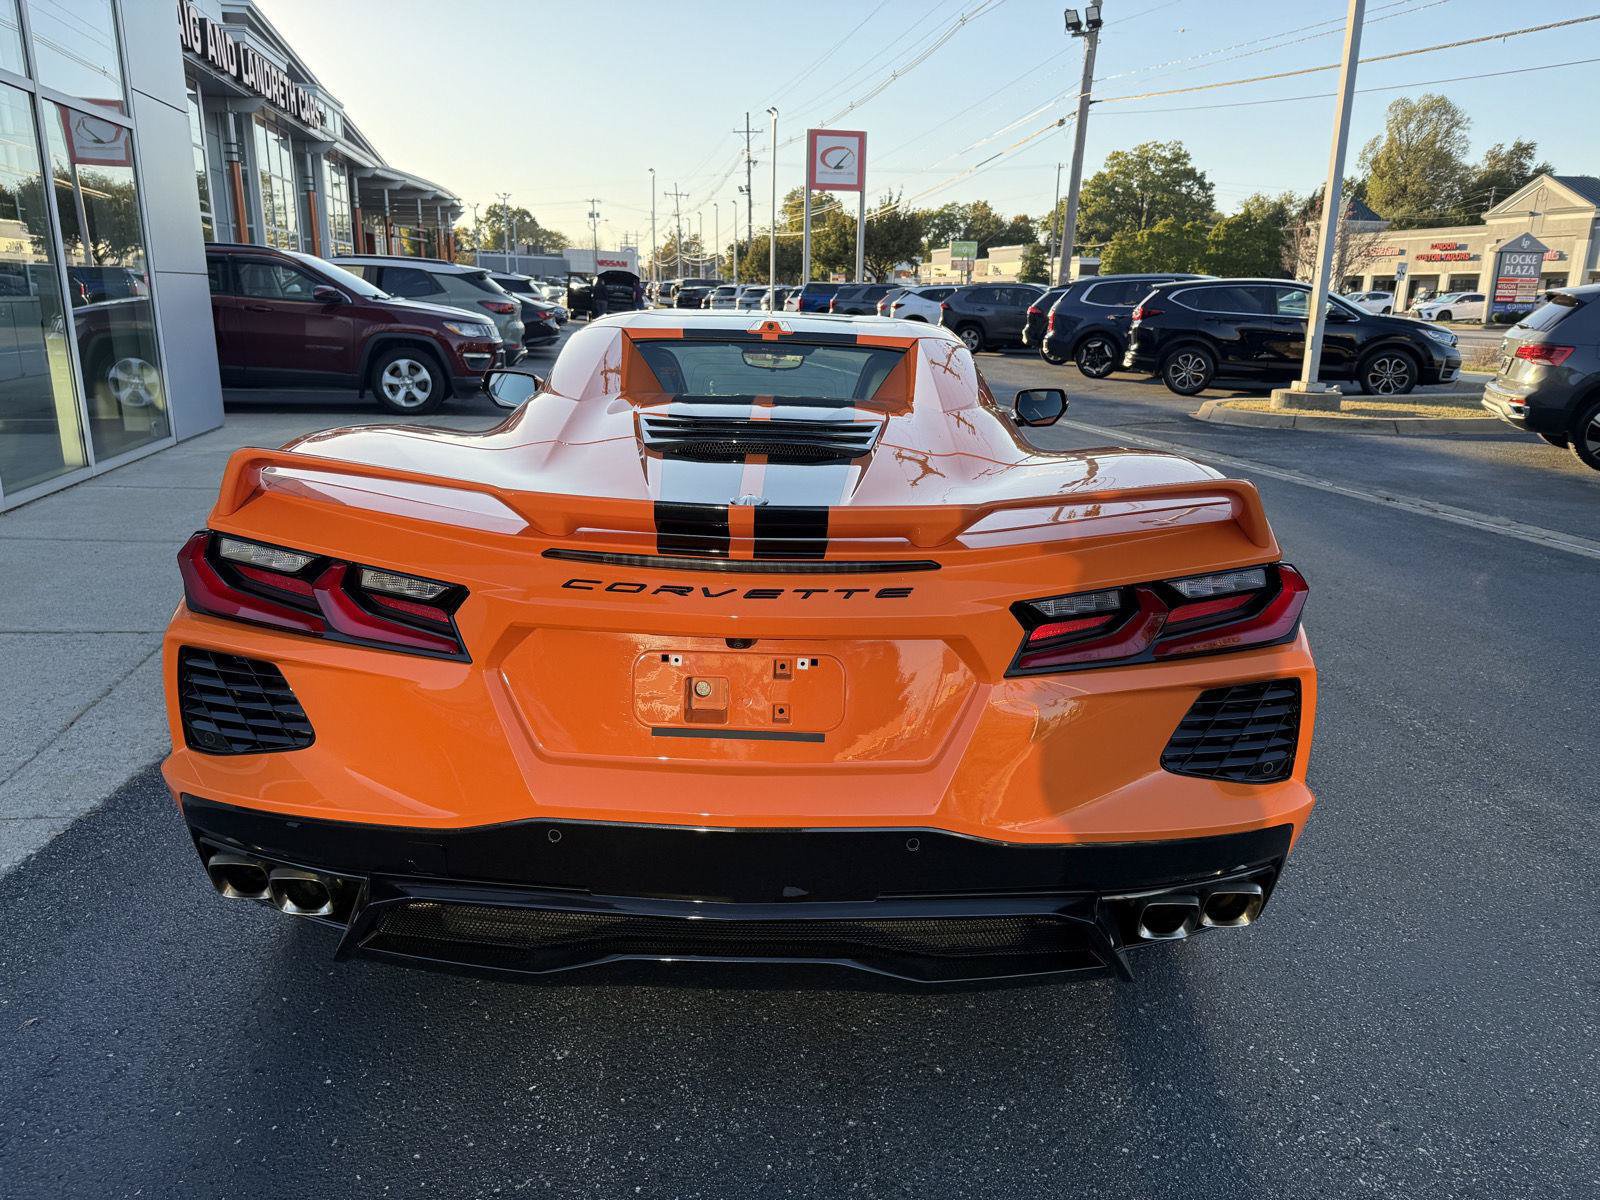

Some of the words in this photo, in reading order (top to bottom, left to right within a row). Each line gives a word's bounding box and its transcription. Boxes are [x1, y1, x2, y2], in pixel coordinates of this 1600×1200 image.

[206, 18, 237, 77] AND
[239, 42, 298, 116] LANDRETH
[298, 89, 321, 129] CARS
[597, 259, 628, 267] NISSAN
[1505, 254, 1537, 264] LOCKE
[1504, 265, 1535, 275] PLAZA
[561, 578, 914, 600] CORVETTE
